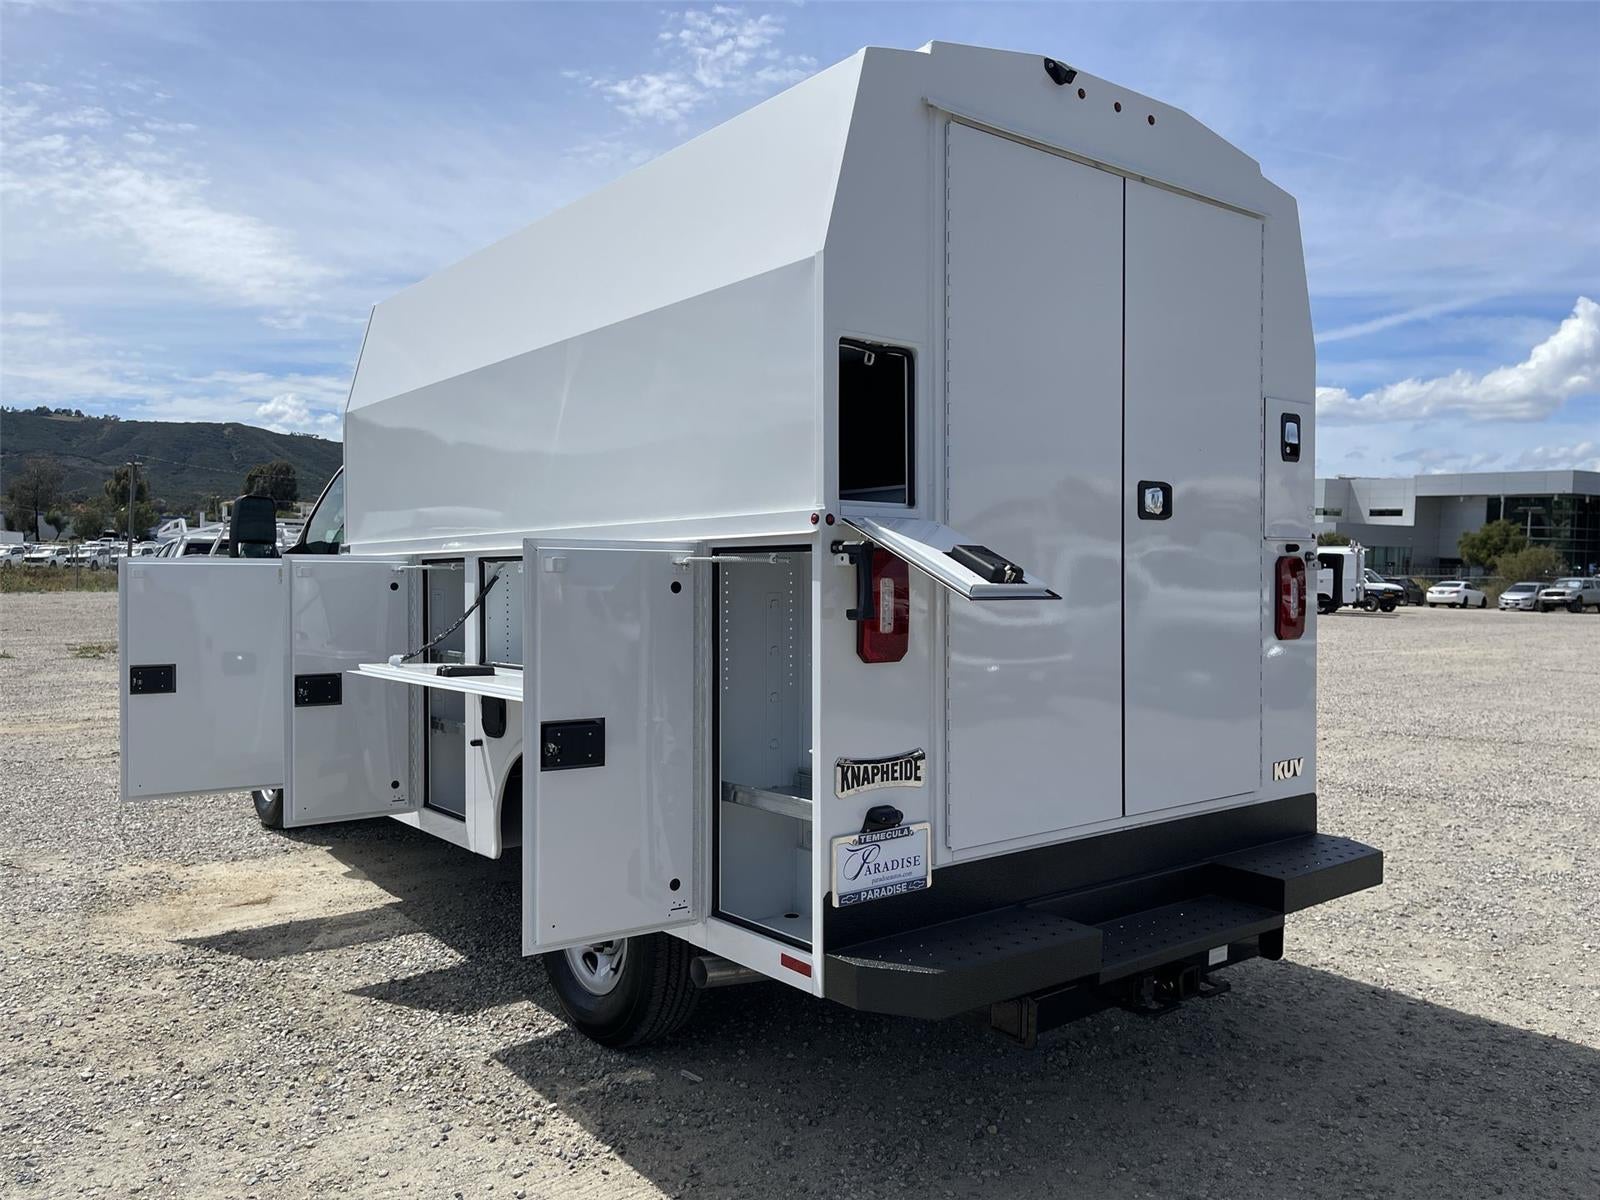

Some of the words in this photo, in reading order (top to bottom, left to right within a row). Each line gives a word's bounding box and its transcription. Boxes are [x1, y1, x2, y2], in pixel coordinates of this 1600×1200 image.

[840, 757, 922, 792] KNAPHEIDE
[1272, 756, 1304, 781] KUV
[859, 828, 909, 844] TEMECULA
[843, 843, 921, 881] PARADISE
[860, 882, 908, 901] PARADISE
